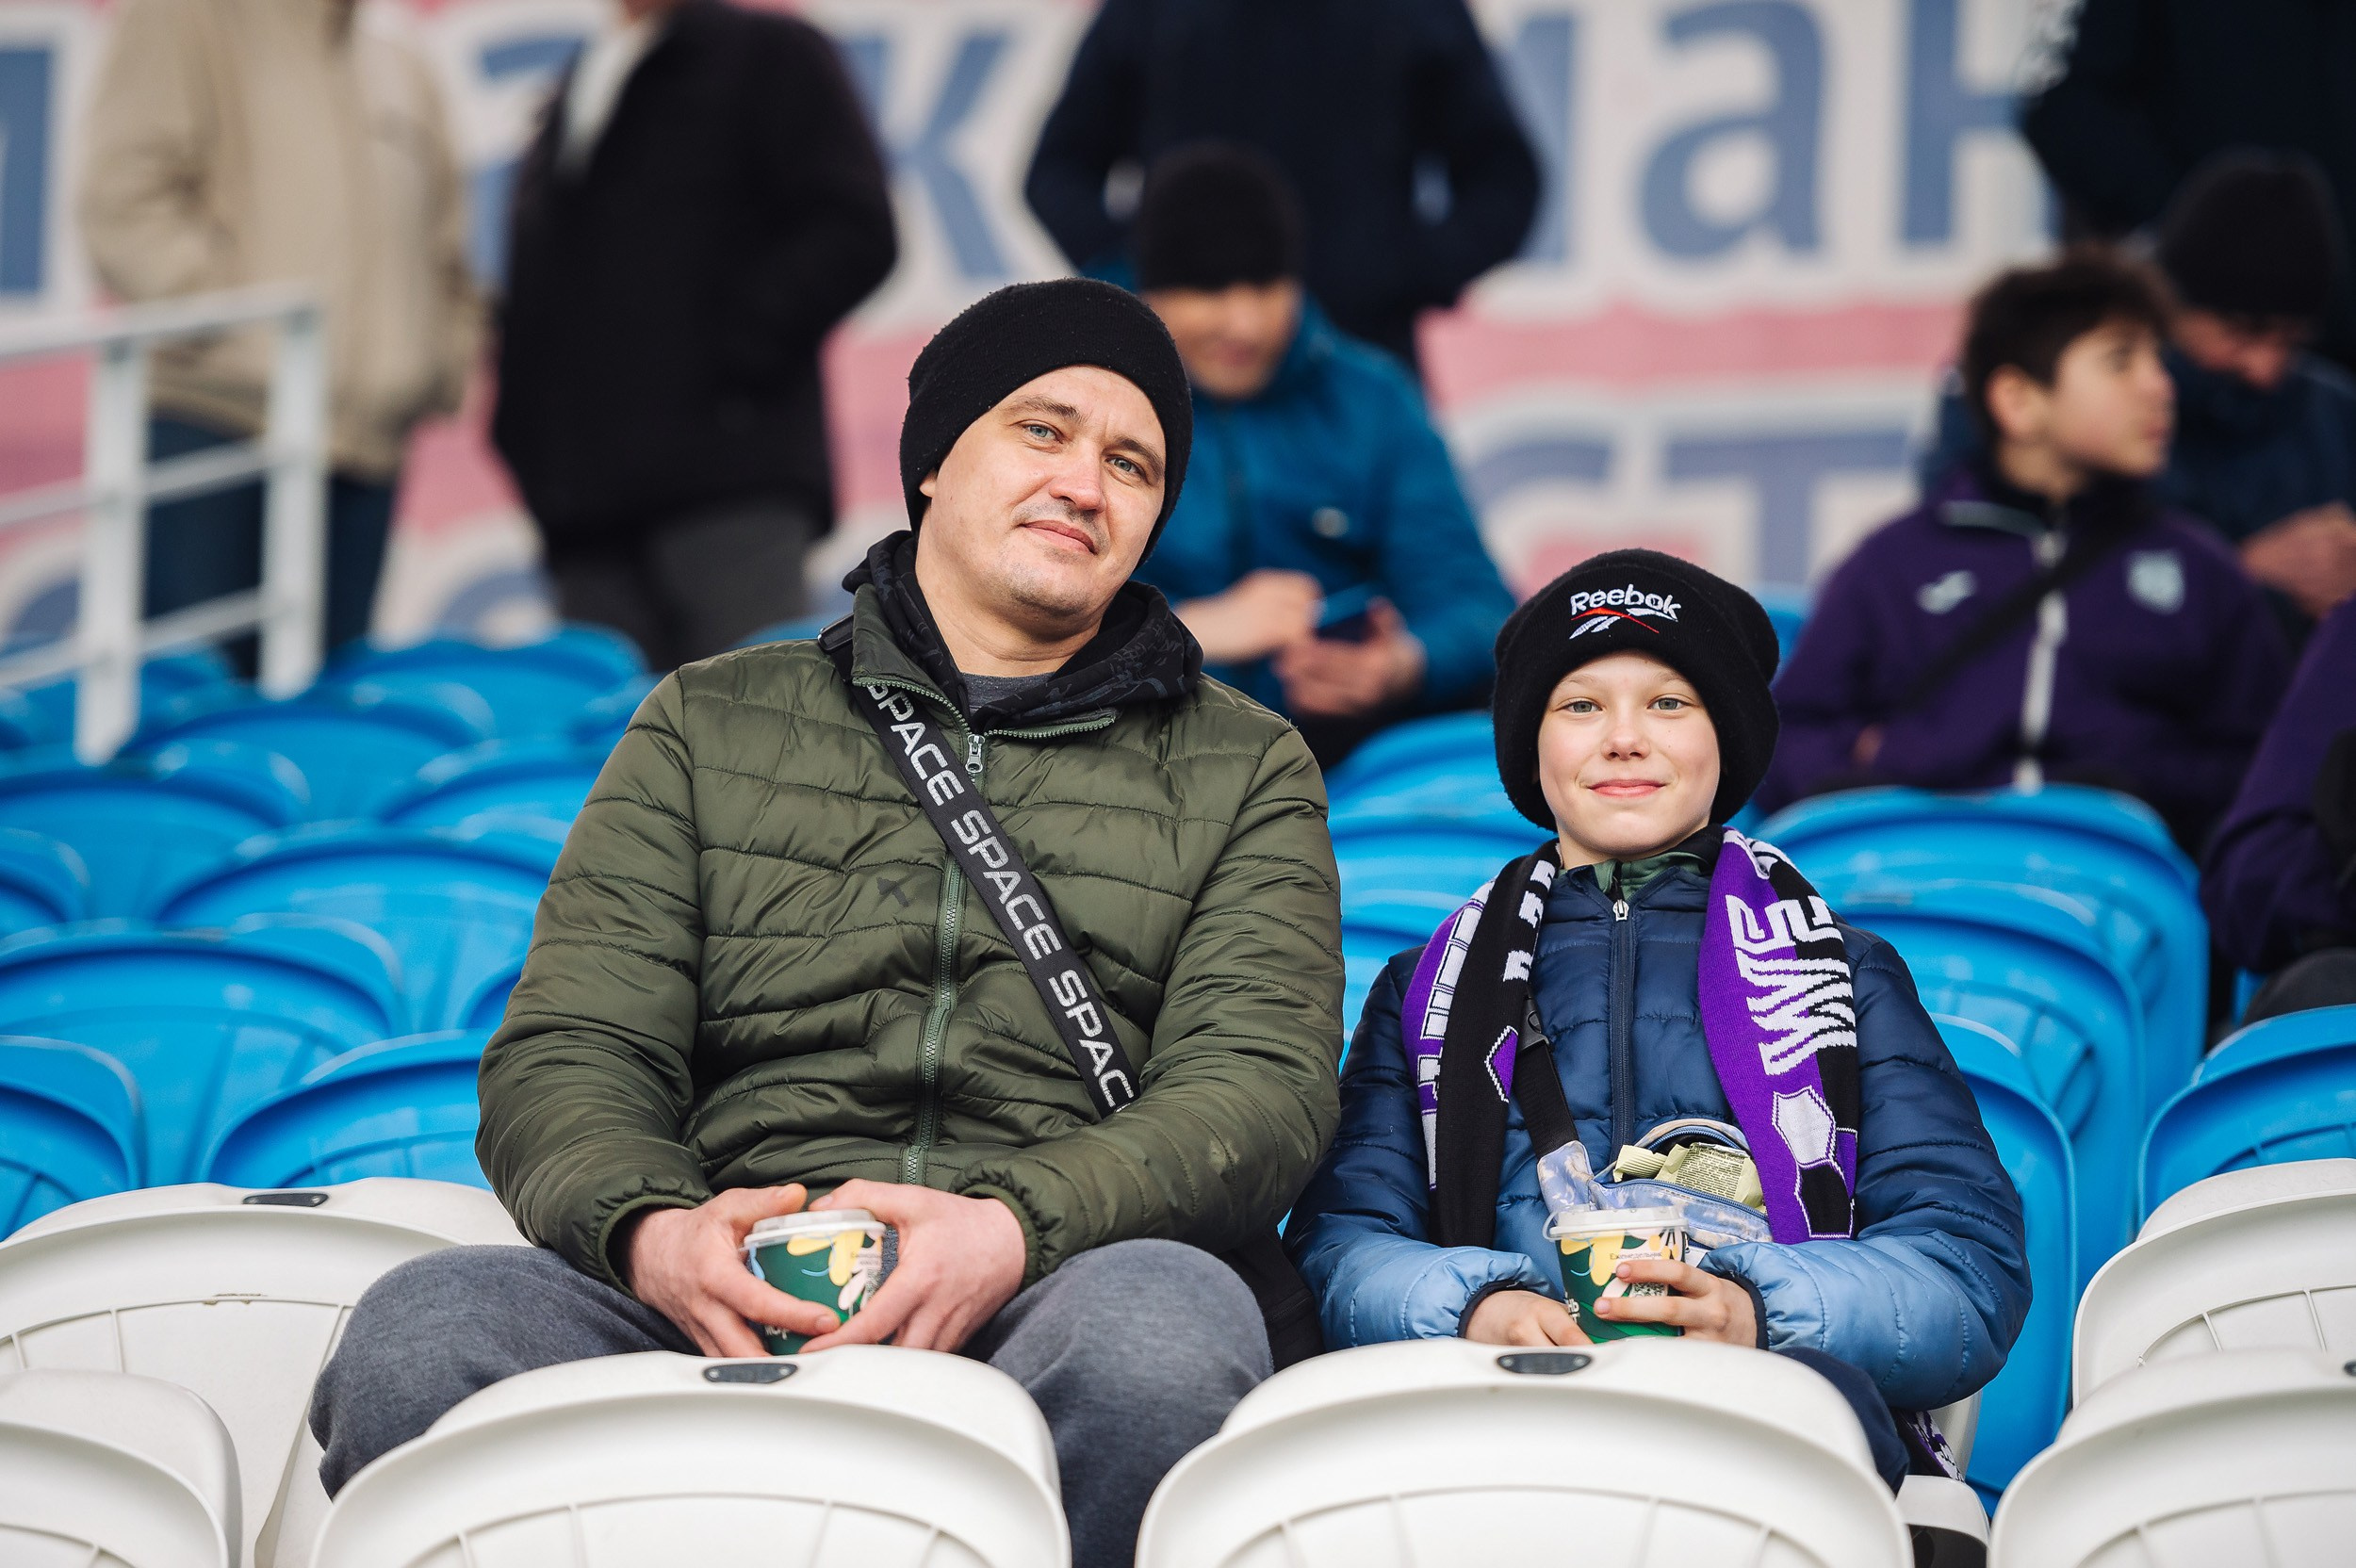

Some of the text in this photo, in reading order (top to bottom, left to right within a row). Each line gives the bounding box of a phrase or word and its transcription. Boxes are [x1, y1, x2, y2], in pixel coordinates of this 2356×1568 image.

[1570, 583, 1682, 621] Reebok
[950, 809, 1063, 961] SPACE
[1047, 969, 1135, 1114] SPAC
